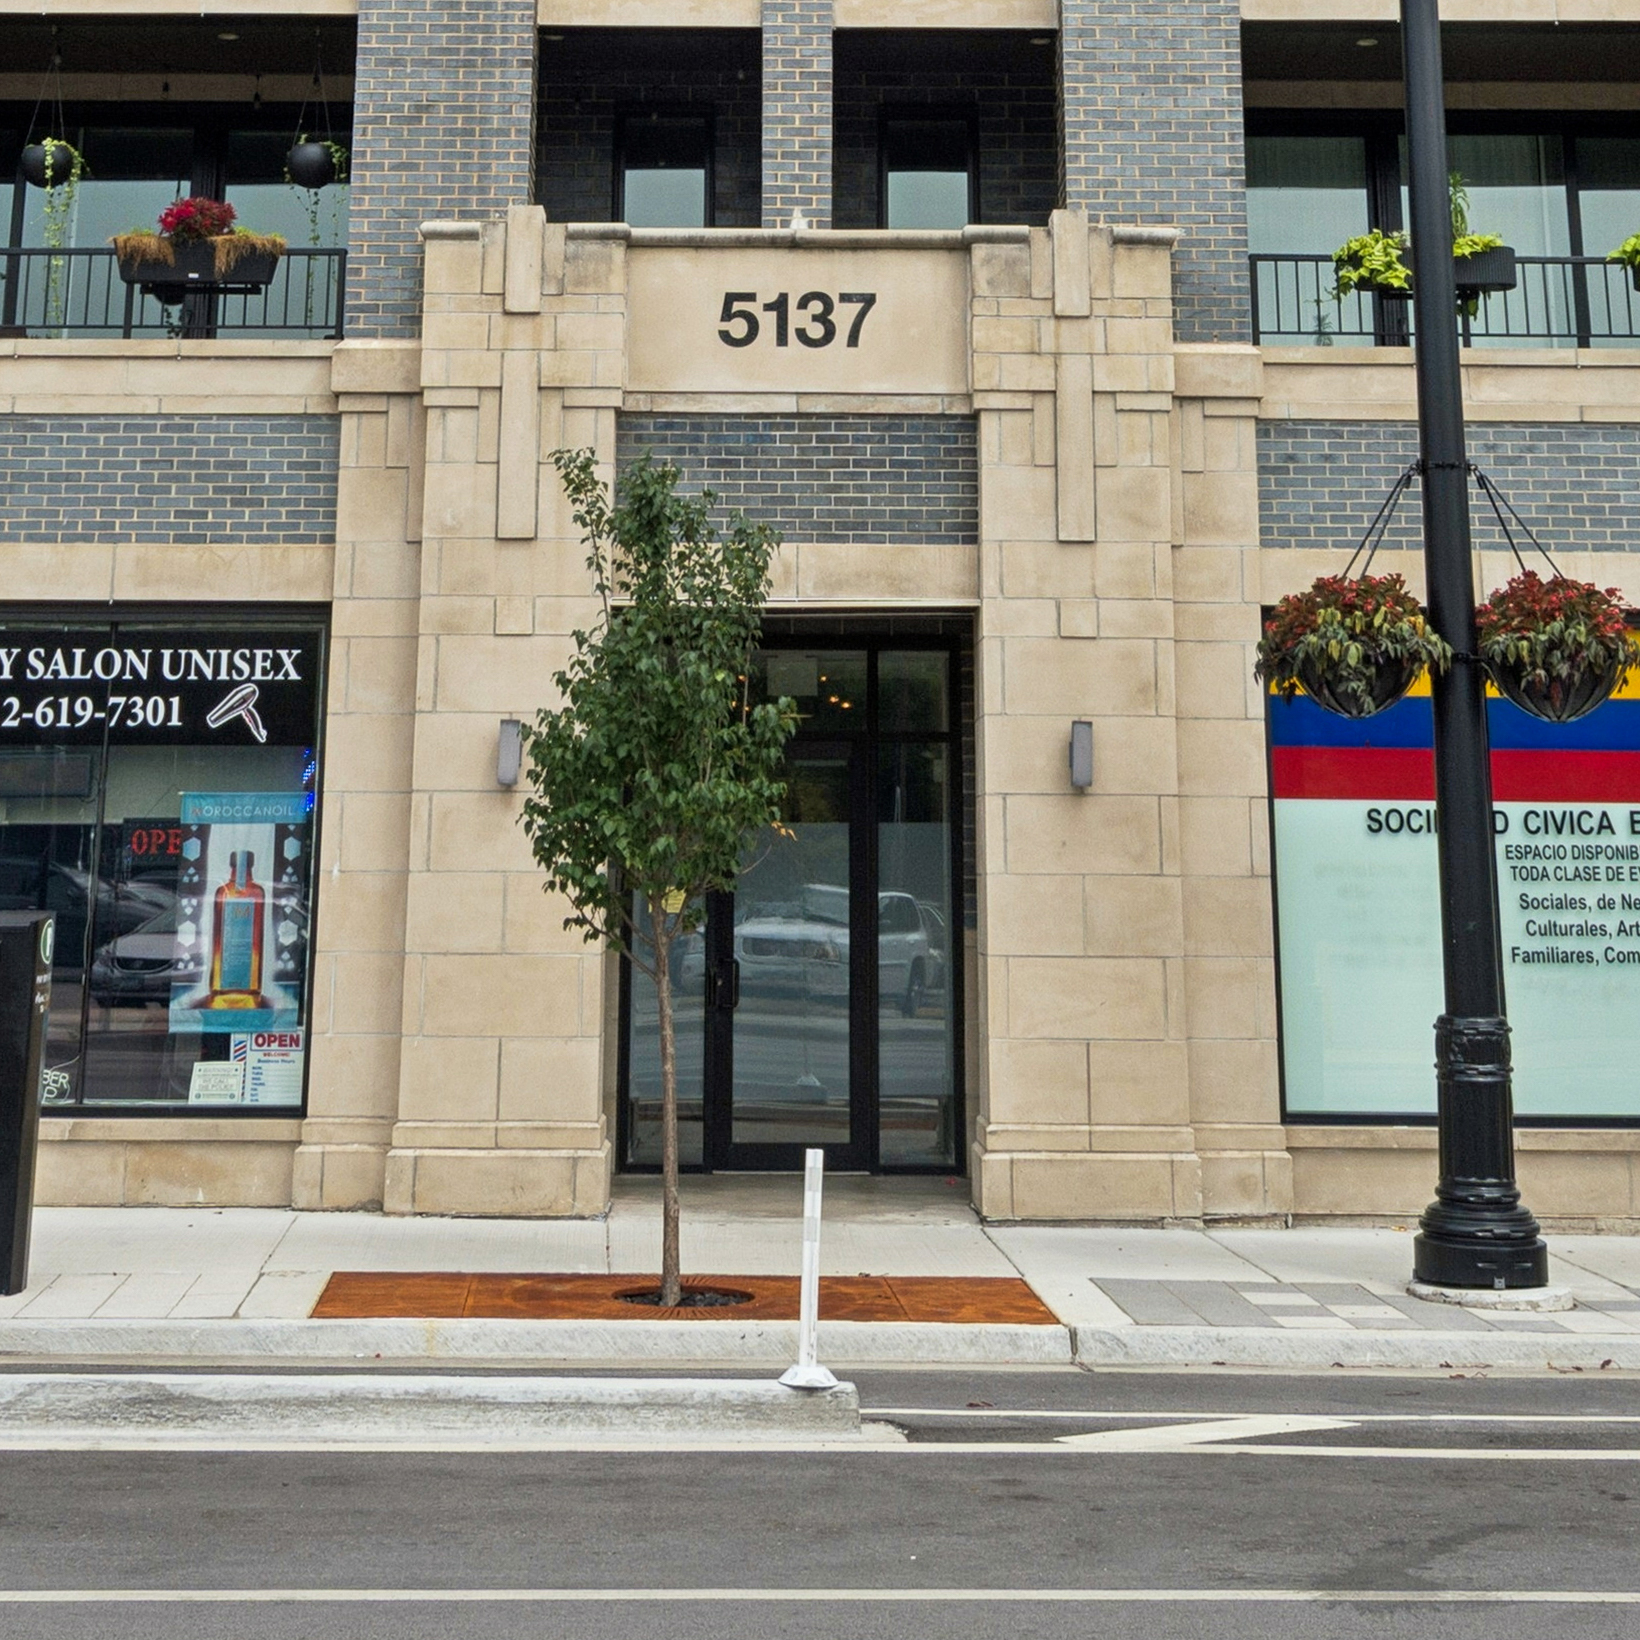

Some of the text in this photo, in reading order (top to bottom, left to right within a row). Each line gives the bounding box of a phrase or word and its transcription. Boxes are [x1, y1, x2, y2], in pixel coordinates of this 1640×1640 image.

[717, 291, 877, 348] 5137
[26, 648, 152, 680] SALON
[161, 649, 302, 680] UNISEX
[1367, 808, 1510, 834] SOCID
[1523, 810, 1616, 836] CIVICA
[131, 829, 182, 854] OPE
[1505, 844, 1567, 860] ESPACIO
[1510, 866, 1550, 881] TODA
[1554, 866, 1601, 881] CLASE
[1606, 866, 1625, 881] DE
[1519, 893, 1592, 912] Sociales,
[1597, 893, 1616, 910] de
[1525, 919, 1612, 939] Culturales,
[1511, 946, 1600, 966] Familiares,
[254, 1033, 300, 1048] OPEN
